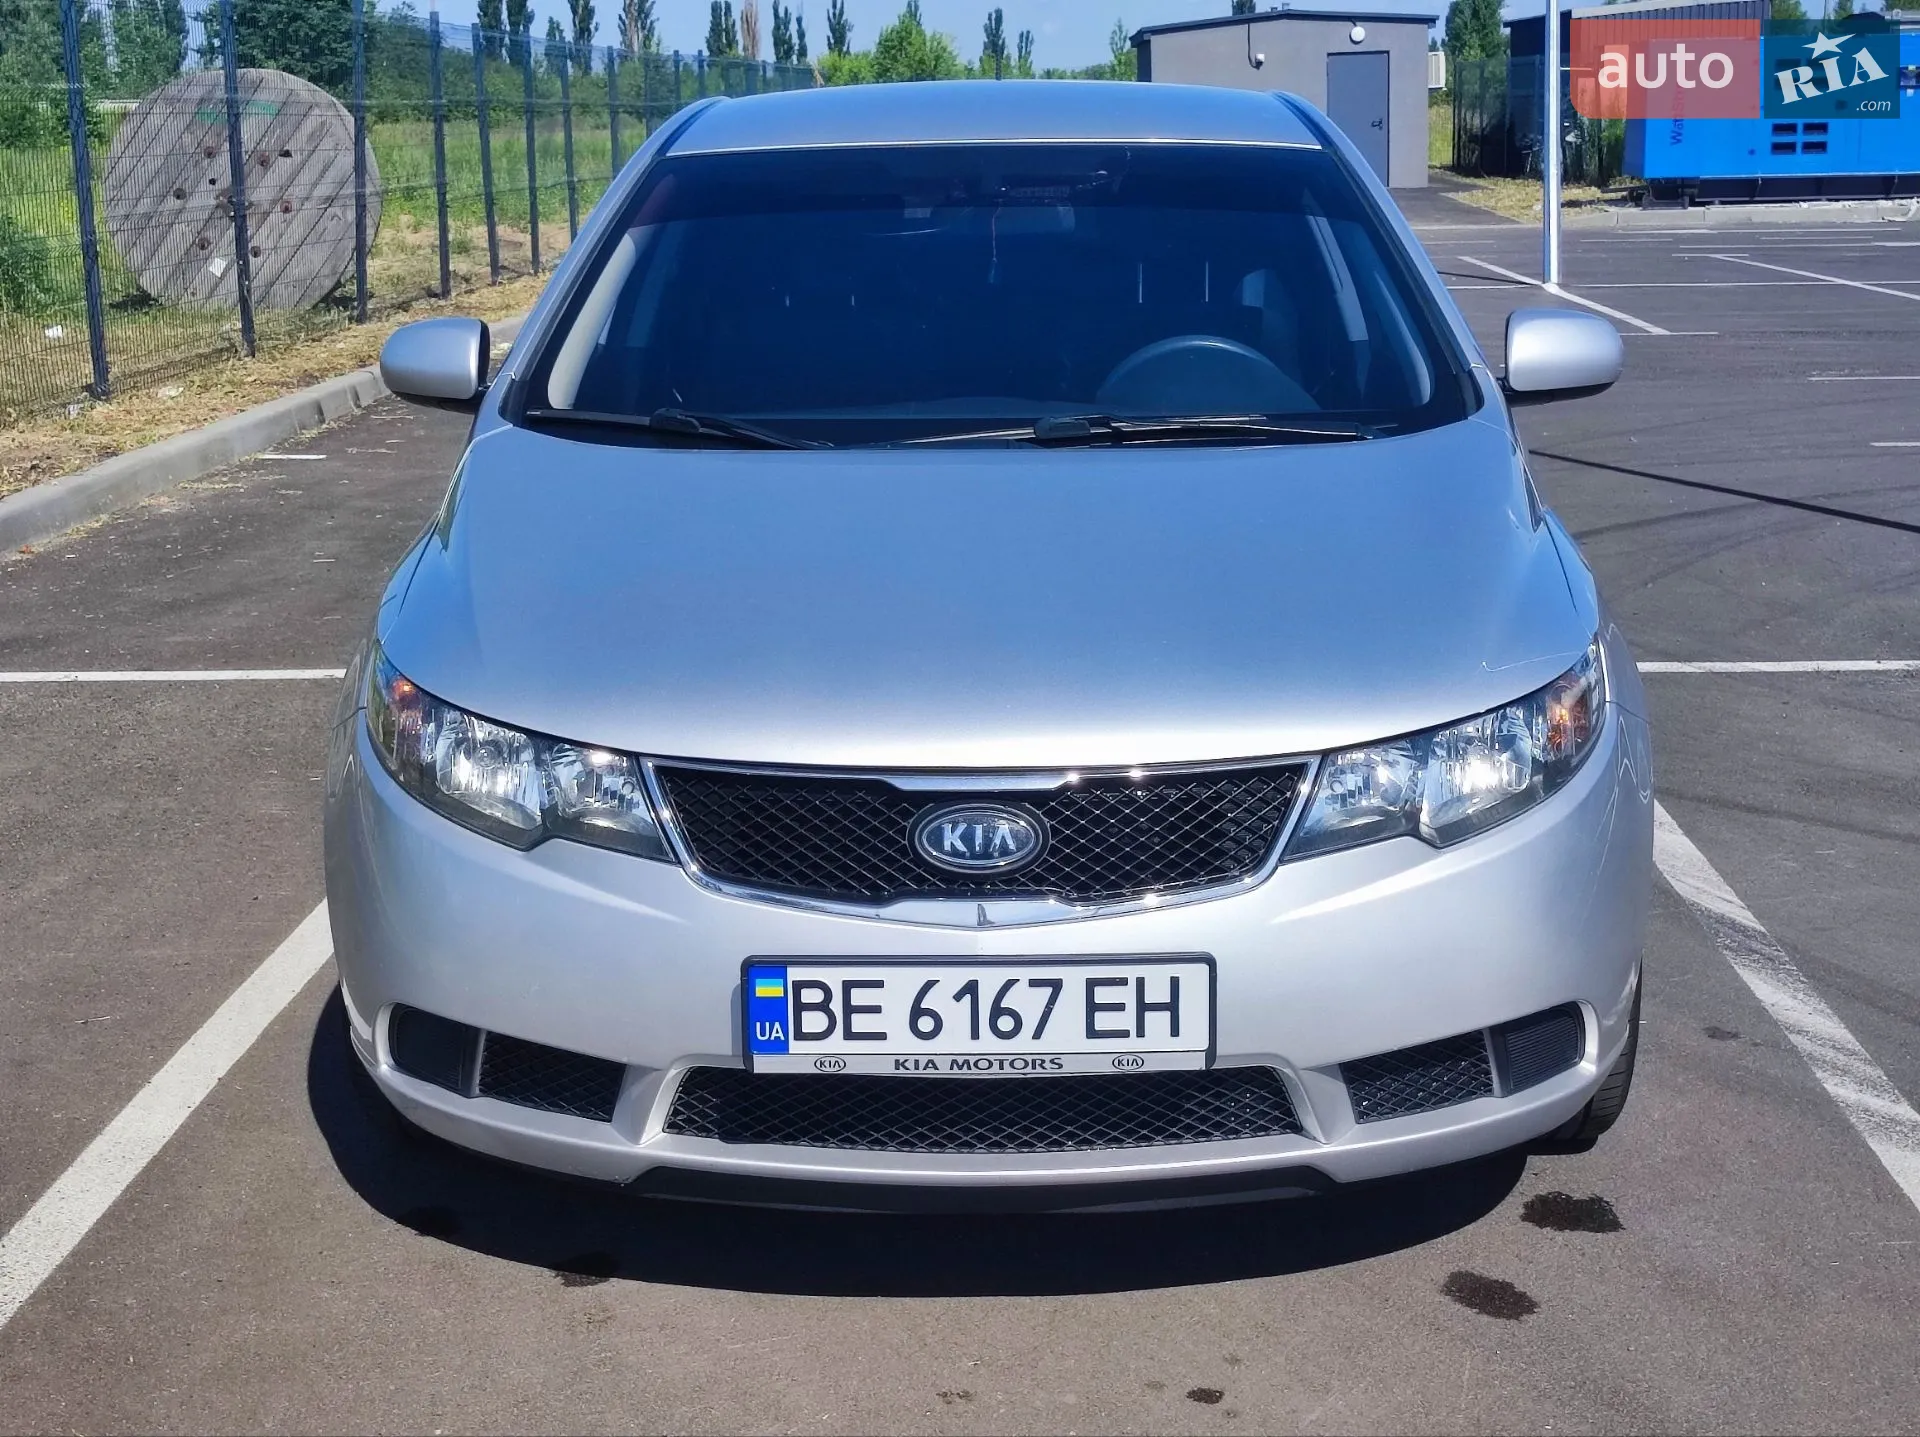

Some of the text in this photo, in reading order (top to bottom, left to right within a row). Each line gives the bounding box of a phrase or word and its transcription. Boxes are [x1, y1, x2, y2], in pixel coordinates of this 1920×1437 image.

[941, 823, 1017, 853] KIA
[792, 976, 1180, 1041] BE 6167 EH
[756, 1022, 785, 1041] UA
[819, 1058, 842, 1070] KIA
[893, 1057, 1064, 1071] KIA MOTORS
[1116, 1056, 1140, 1068] KIA
